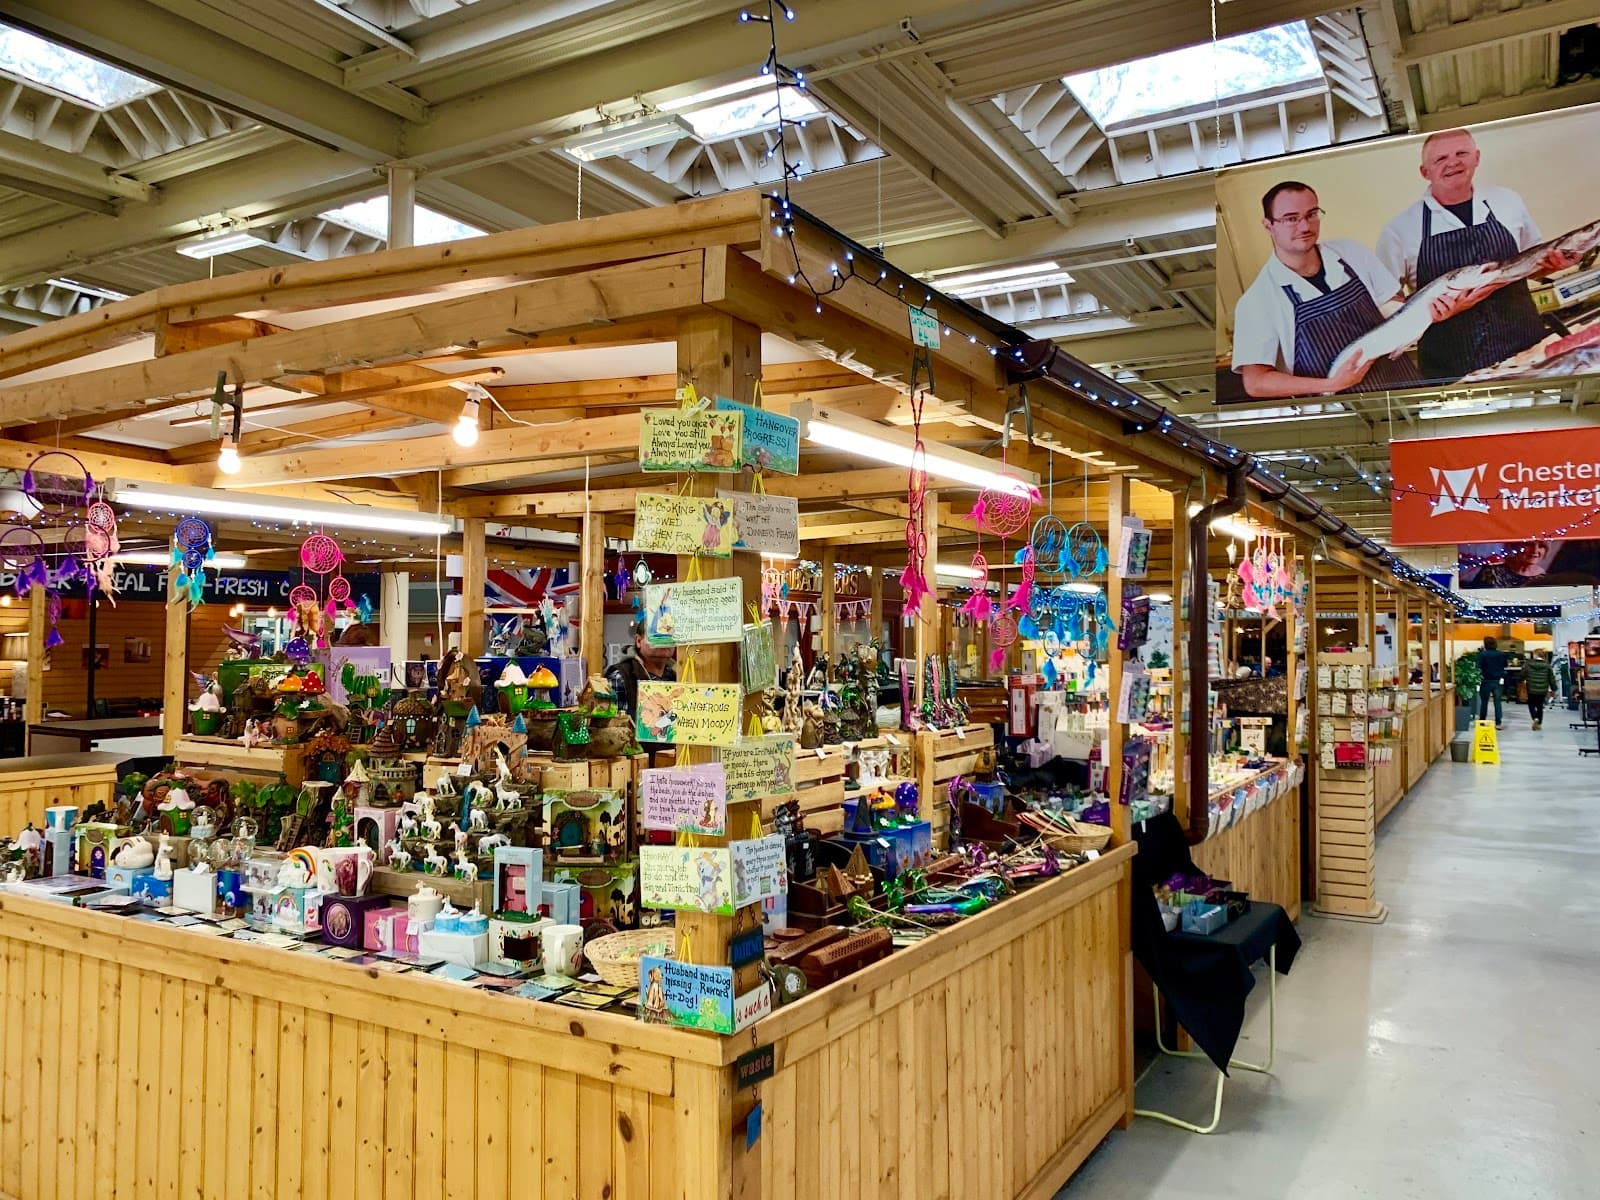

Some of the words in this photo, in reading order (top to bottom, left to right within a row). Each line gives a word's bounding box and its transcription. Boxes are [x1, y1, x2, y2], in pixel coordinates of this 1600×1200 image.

[653, 416, 675, 426] Loved
[677, 420, 691, 430] you
[756, 413, 798, 437] HANGOVER
[653, 427, 670, 437] Love
[675, 430, 688, 440] you
[689, 429, 706, 439] still
[651, 437, 676, 452] Always
[678, 438, 698, 449] Loved
[651, 447, 676, 461] Always
[1499, 461, 1600, 484] Chester
[1499, 484, 1600, 510] Market
[640, 500, 652, 511] No
[215, 577, 268, 597] FRESH
[672, 587, 681, 600] My
[683, 584, 710, 596] husband
[711, 584, 727, 594] said
[689, 596, 719, 608] shopping
[675, 700, 730, 713] DANGEROUS
[677, 716, 698, 728] WHEN
[722, 749, 731, 761] If
[732, 750, 742, 761] you
[650, 774, 656, 783] I
[756, 769, 773, 780] charge
[731, 781, 749, 794] putting
[749, 781, 756, 791] up
[757, 780, 767, 792] with
[665, 963, 698, 980] Husband
[700, 972, 715, 983] and
[715, 973, 731, 991] Dog
[700, 983, 729, 999] Reward
[664, 991, 678, 1001] for
[678, 993, 698, 1009] Dog!
[744, 991, 762, 1018] such
[763, 995, 769, 1007] a
[741, 1055, 772, 1078] waste
